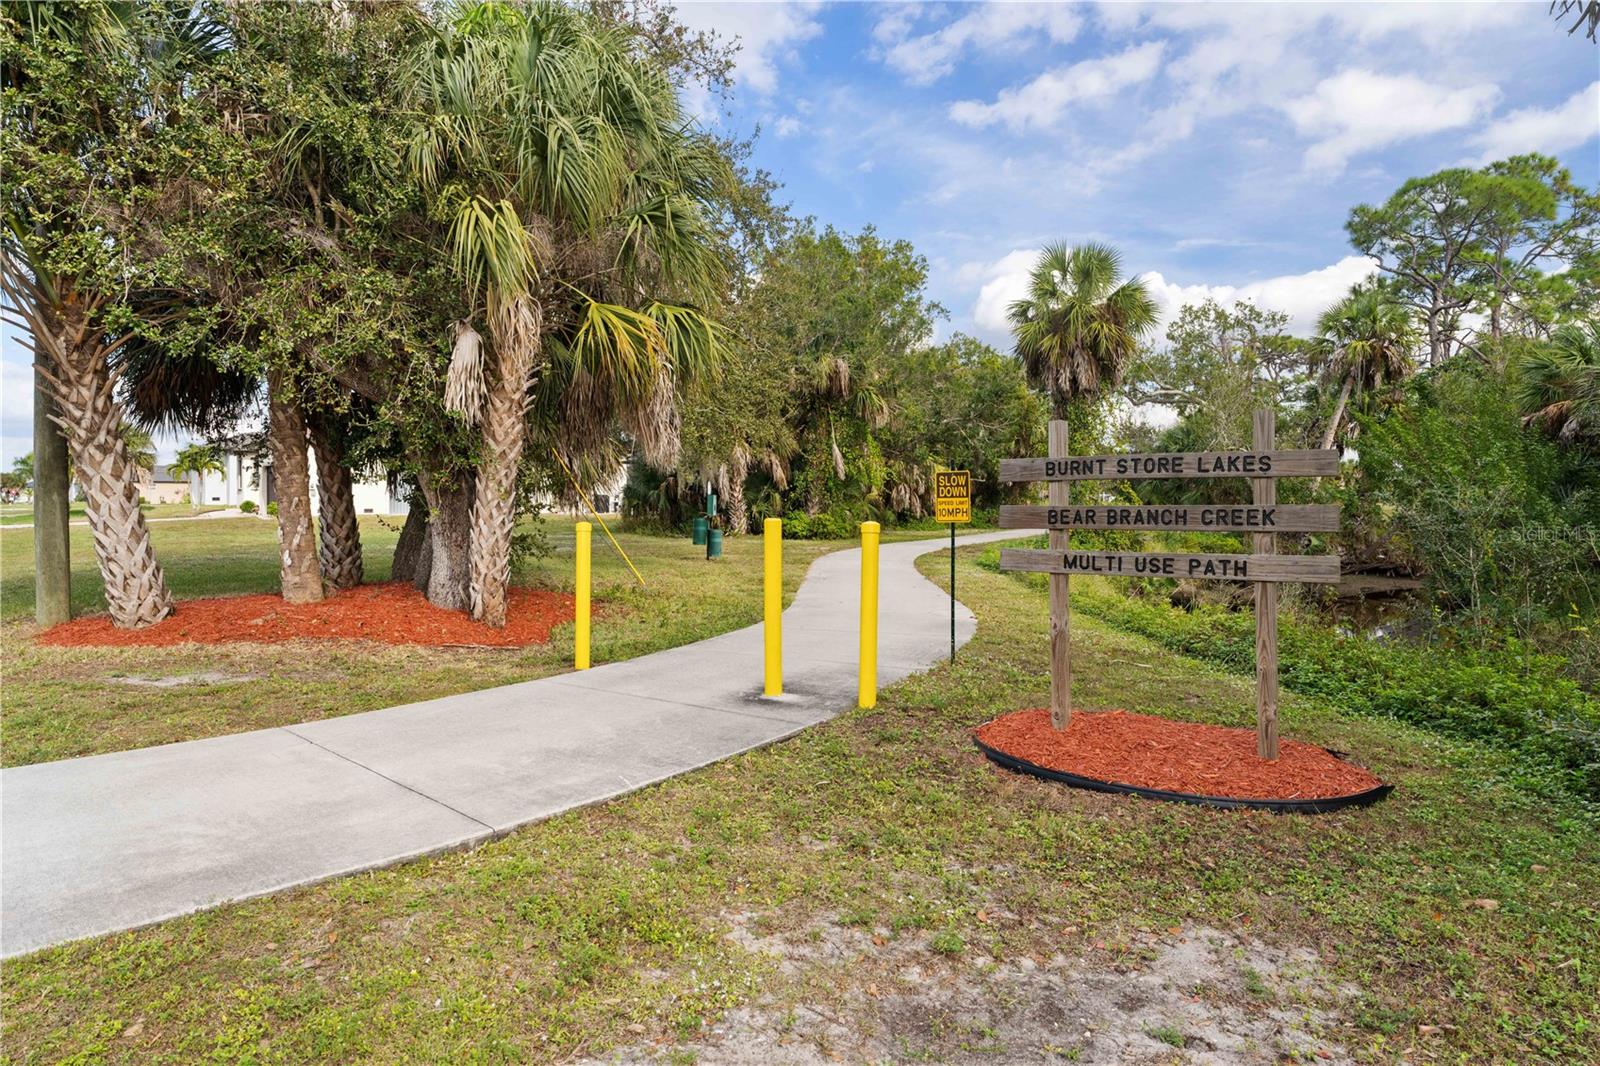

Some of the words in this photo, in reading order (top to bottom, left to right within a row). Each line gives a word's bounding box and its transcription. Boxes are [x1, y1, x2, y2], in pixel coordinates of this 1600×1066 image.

[1045, 459, 1106, 477] BURNT
[1116, 456, 1184, 474] STORE
[1197, 455, 1272, 473] LAKES
[938, 475, 967, 486] SLOW
[939, 486, 967, 497] DOWN
[938, 508, 968, 517] 10MPH
[1047, 508, 1096, 526] BEAR
[1106, 508, 1188, 526] BRANCH
[1200, 508, 1276, 526] CREEK
[1063, 554, 1122, 572] MULTI
[1134, 557, 1175, 574] USE
[1188, 558, 1248, 577] PATH
